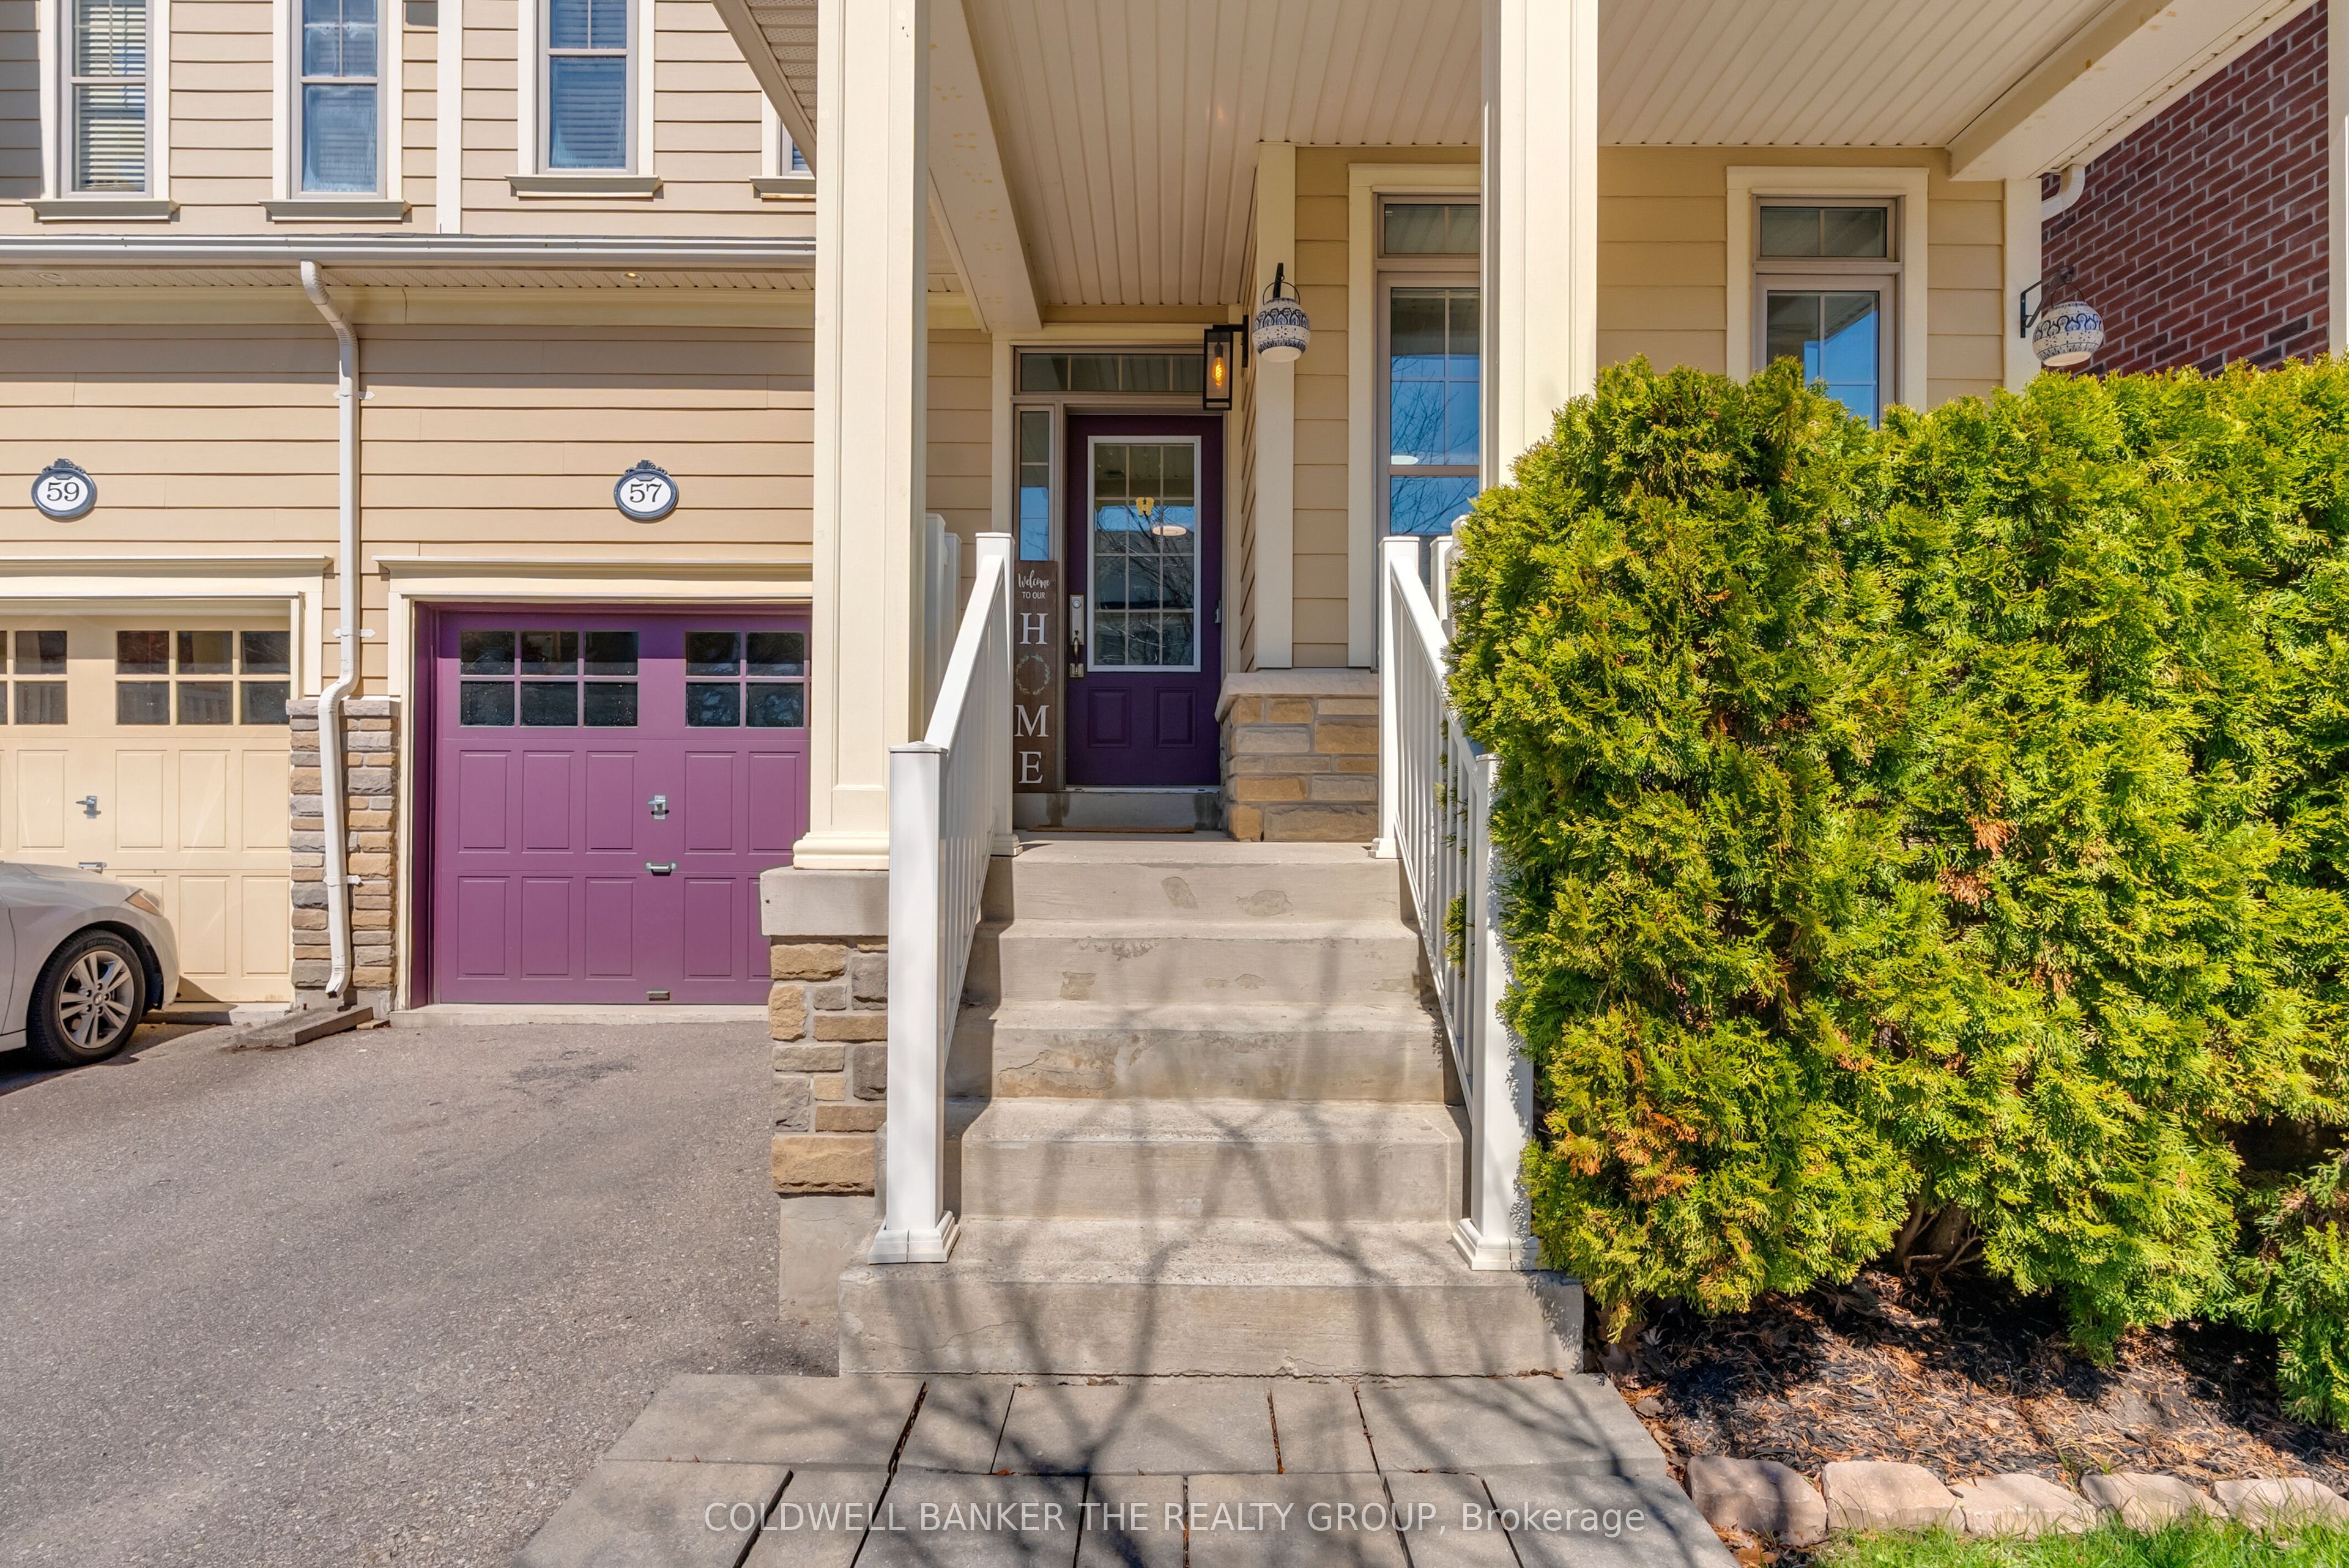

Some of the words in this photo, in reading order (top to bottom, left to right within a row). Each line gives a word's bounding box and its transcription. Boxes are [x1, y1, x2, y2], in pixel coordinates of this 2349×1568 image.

[46, 482, 80, 501] 59
[629, 483, 662, 503] 57
[1018, 569, 1051, 589] Welcome
